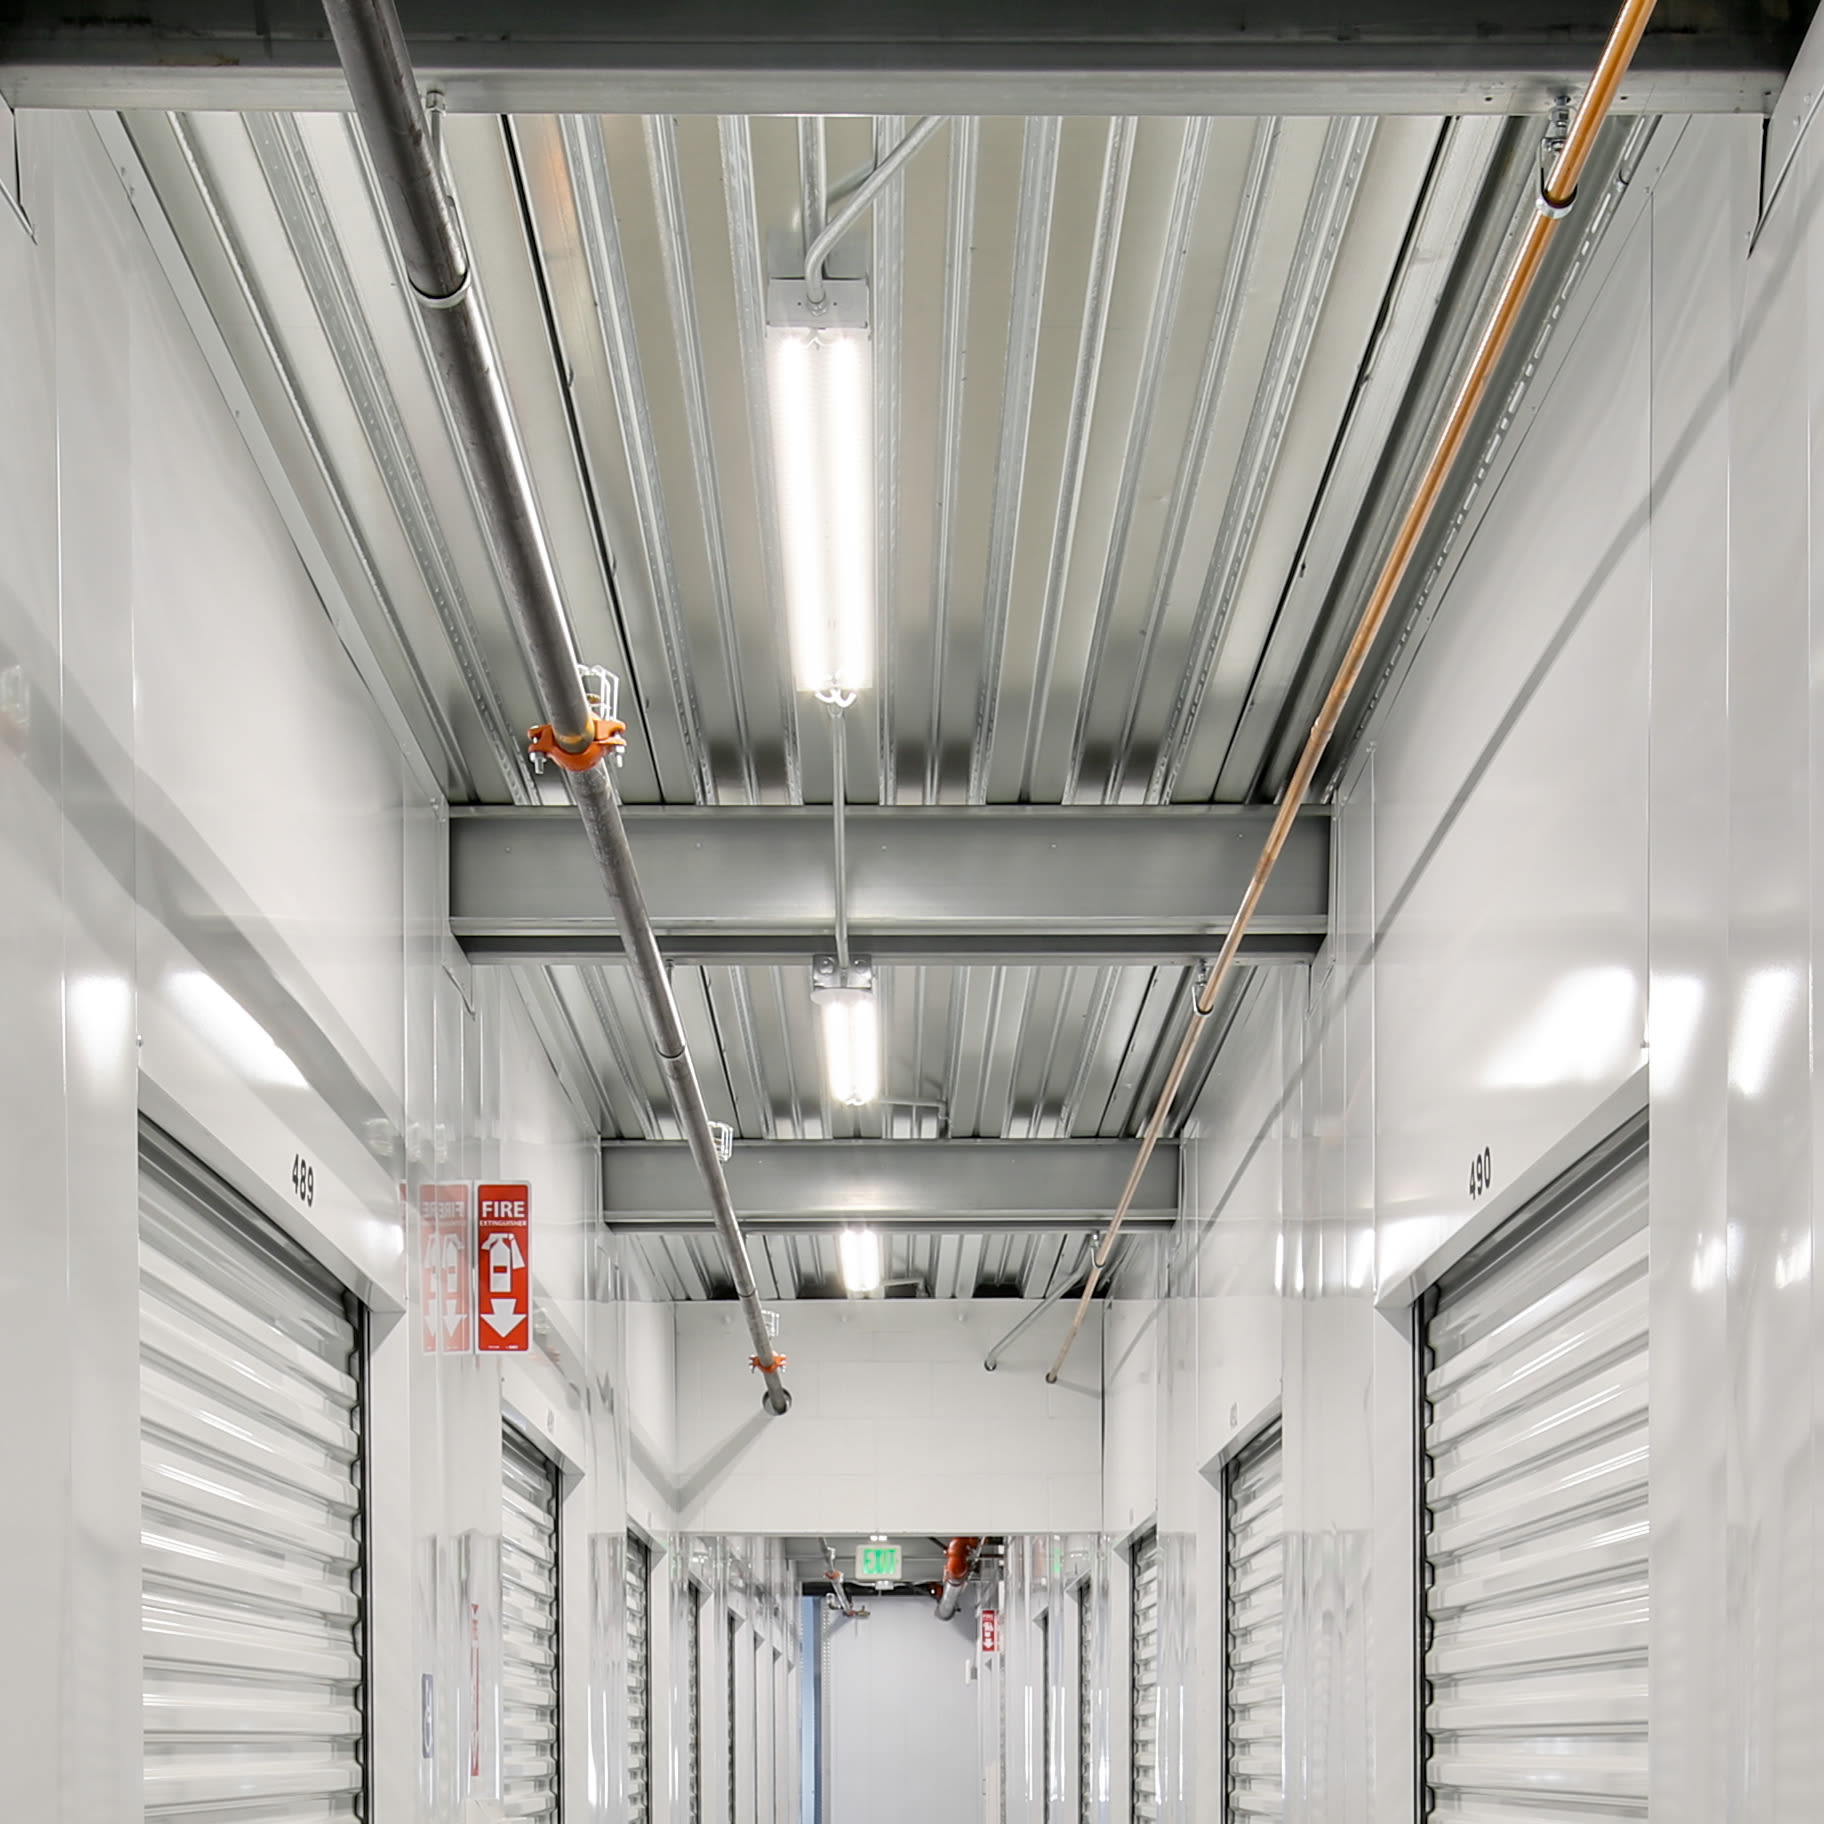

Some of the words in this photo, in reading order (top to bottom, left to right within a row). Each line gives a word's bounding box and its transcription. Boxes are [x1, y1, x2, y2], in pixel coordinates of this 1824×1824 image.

[292, 1153, 314, 1208] 489
[1469, 1146, 1492, 1201] 490
[482, 1200, 525, 1218] FIRE
[863, 1547, 897, 1575] EXIT
